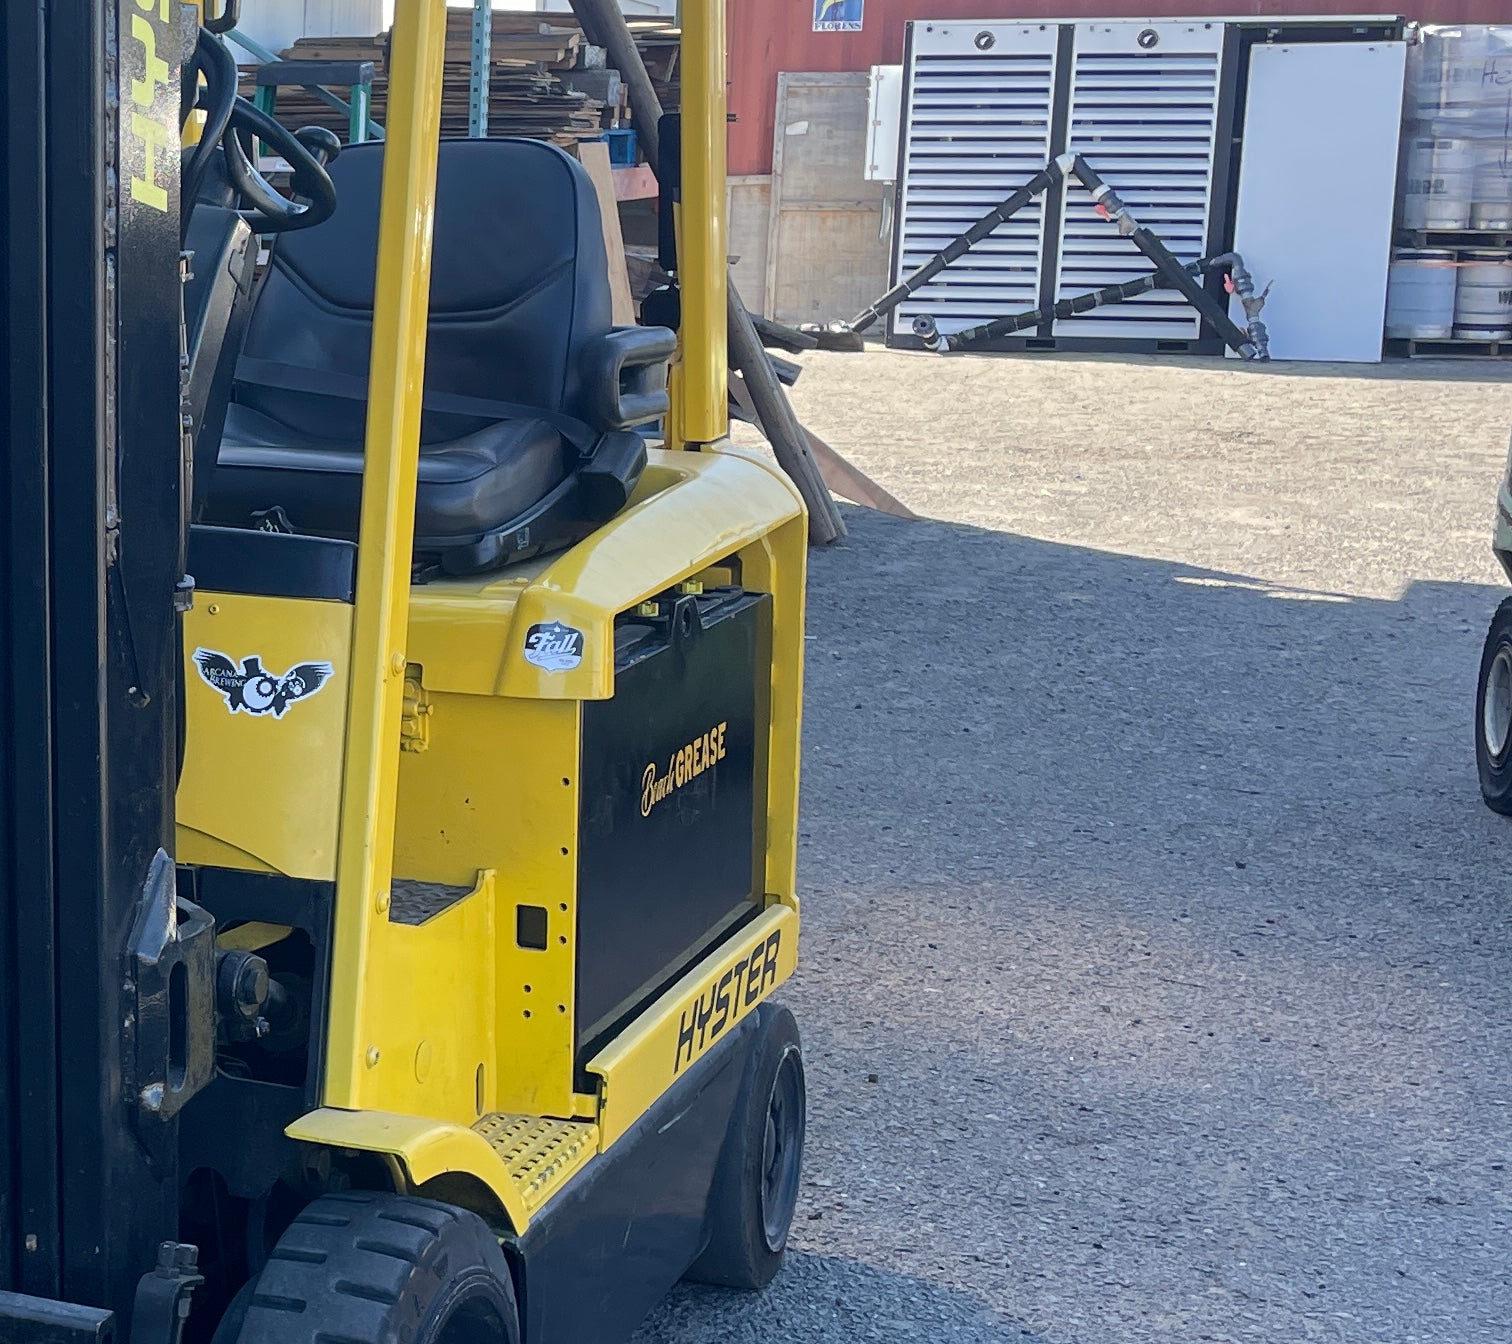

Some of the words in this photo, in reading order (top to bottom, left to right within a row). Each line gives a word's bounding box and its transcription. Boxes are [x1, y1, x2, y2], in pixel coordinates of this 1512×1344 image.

[814, 22, 862, 31] FLORENS
[528, 631, 579, 659] Fall
[202, 666, 239, 679] ARCANA
[675, 721, 727, 788] GREASE
[673, 928, 781, 1075] HYSTER
